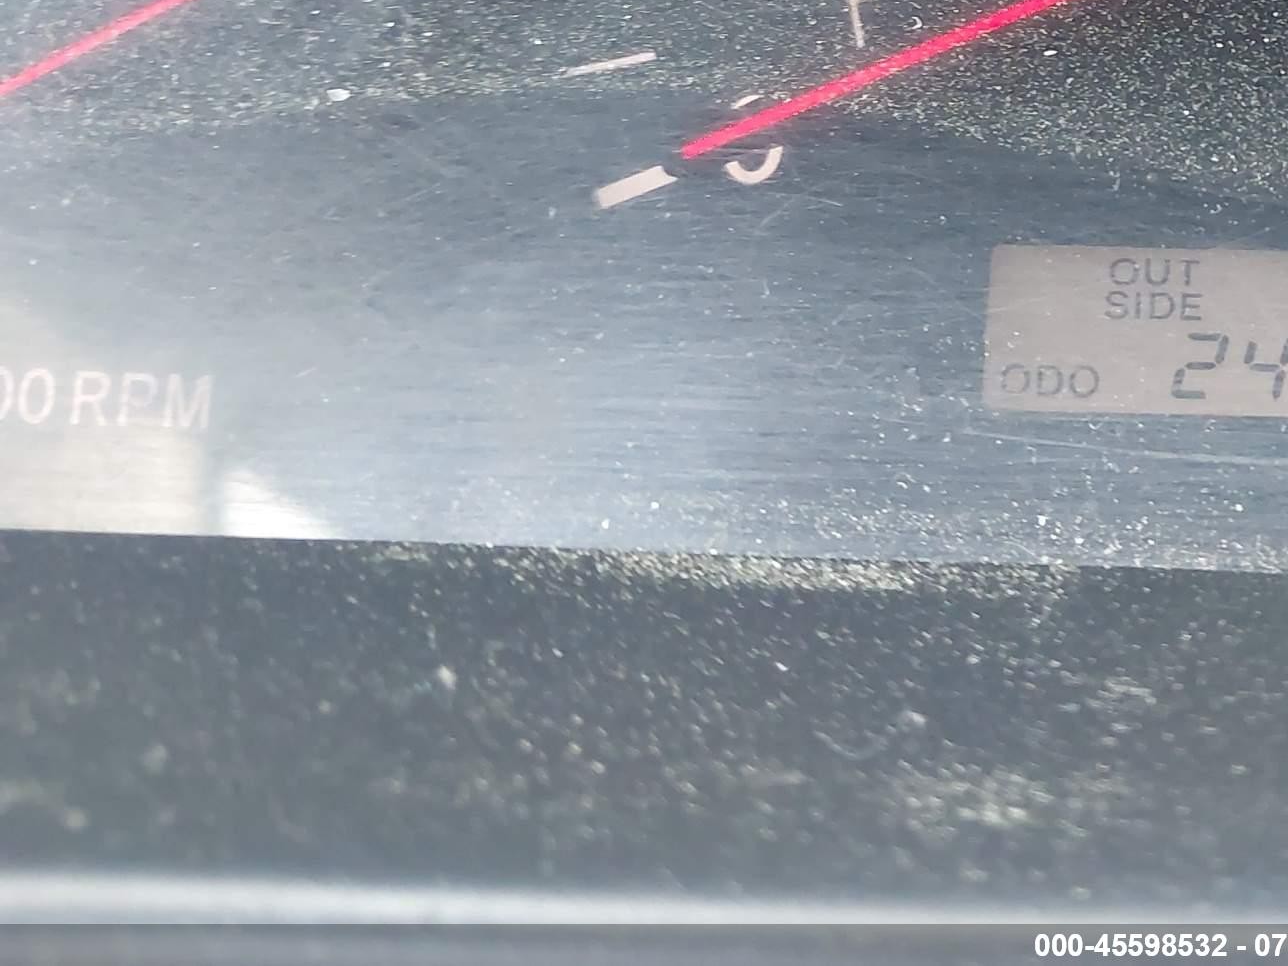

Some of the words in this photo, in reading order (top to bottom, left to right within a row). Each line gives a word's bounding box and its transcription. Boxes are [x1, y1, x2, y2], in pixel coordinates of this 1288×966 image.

[1108, 257, 1201, 287] OUT
[1104, 290, 1204, 323] SIDE
[1000, 362, 1101, 400] ODO
[69, 370, 213, 428] RPM
